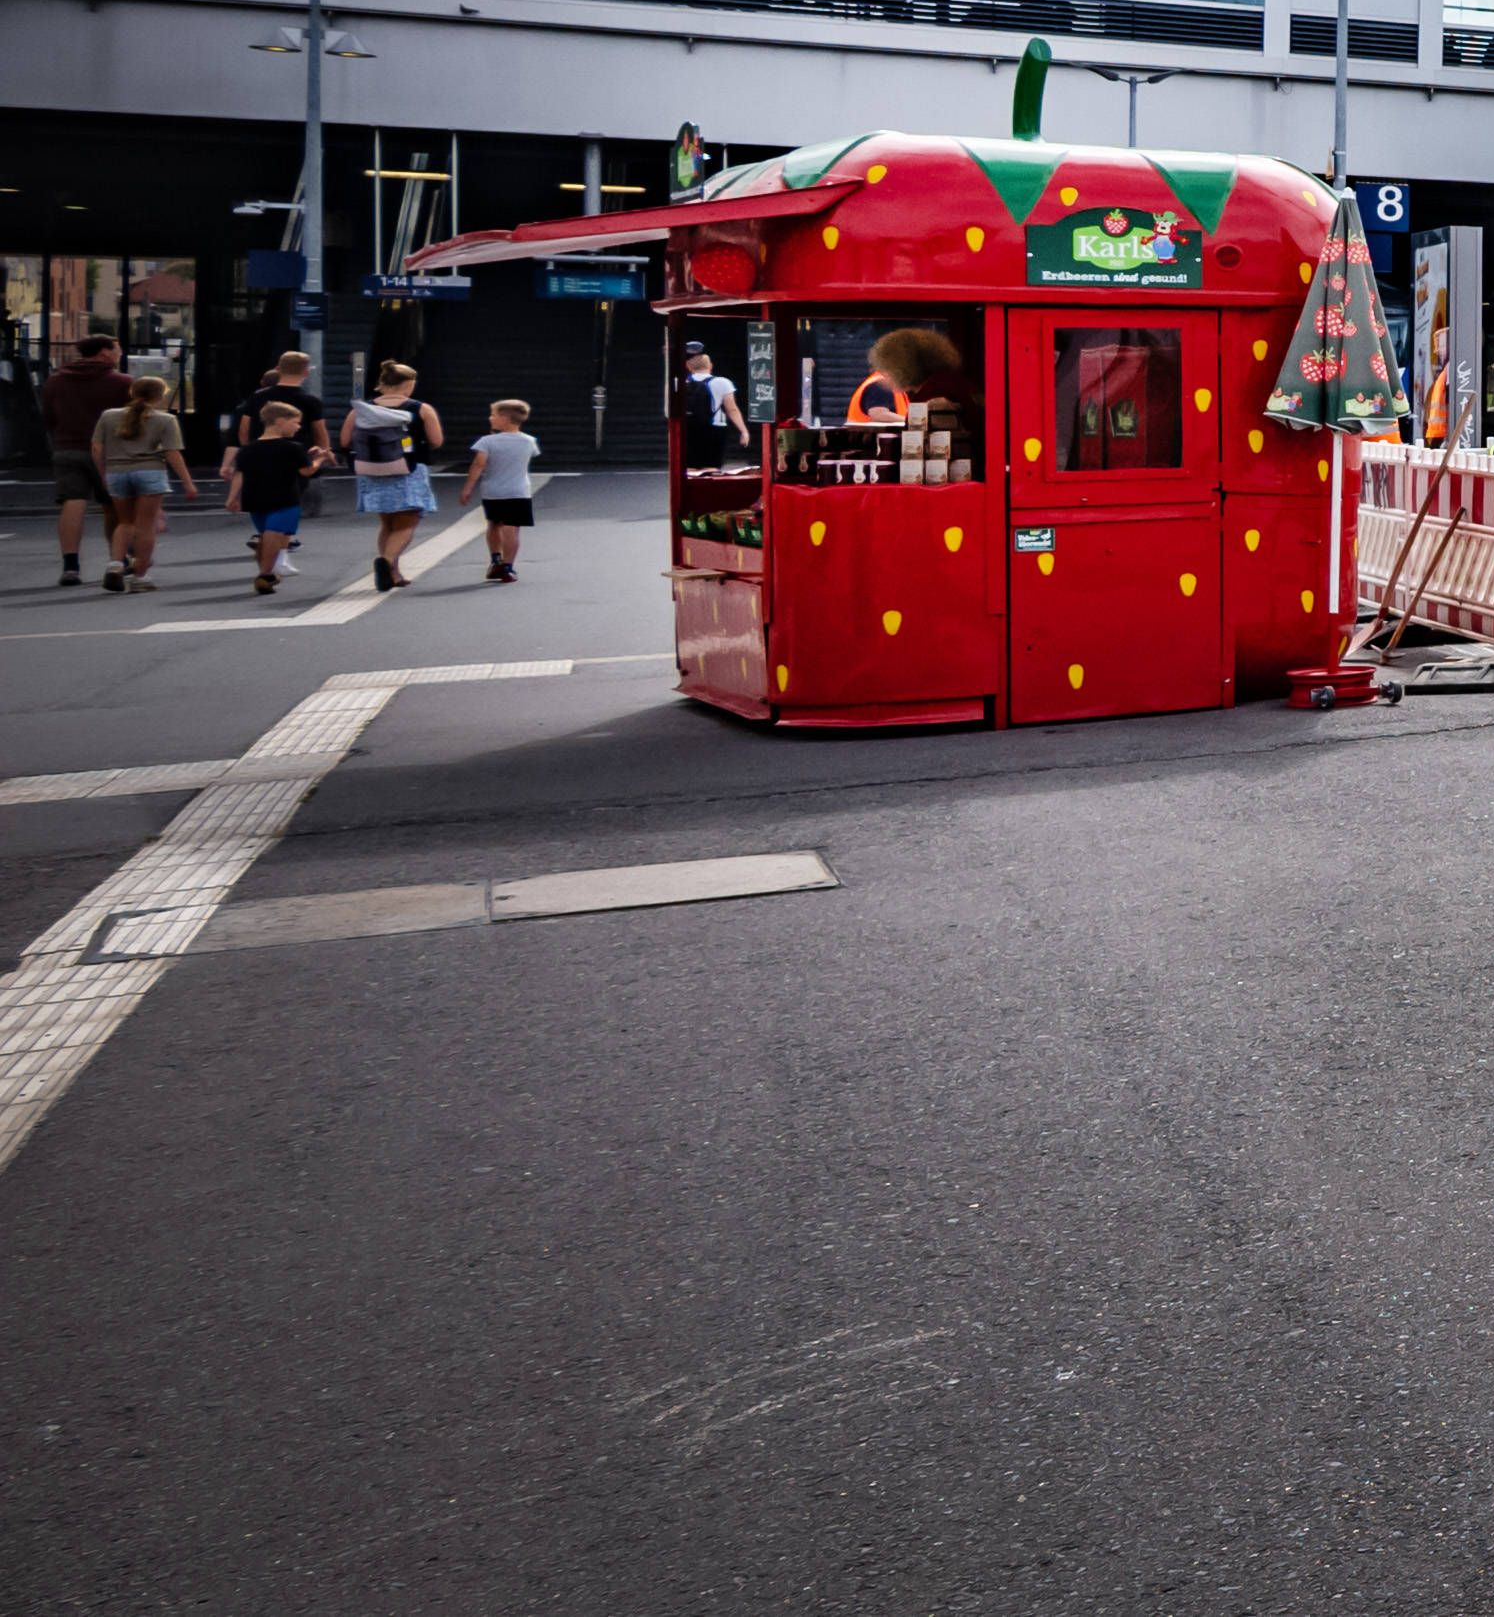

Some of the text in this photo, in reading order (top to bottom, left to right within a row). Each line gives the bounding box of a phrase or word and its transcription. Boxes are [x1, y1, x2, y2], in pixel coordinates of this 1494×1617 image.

[1377, 185, 1404, 222] 8
[1078, 235, 1153, 259] Karls
[1042, 270, 1110, 282] Erdbeeren
[1141, 273, 1188, 284] gesund!
